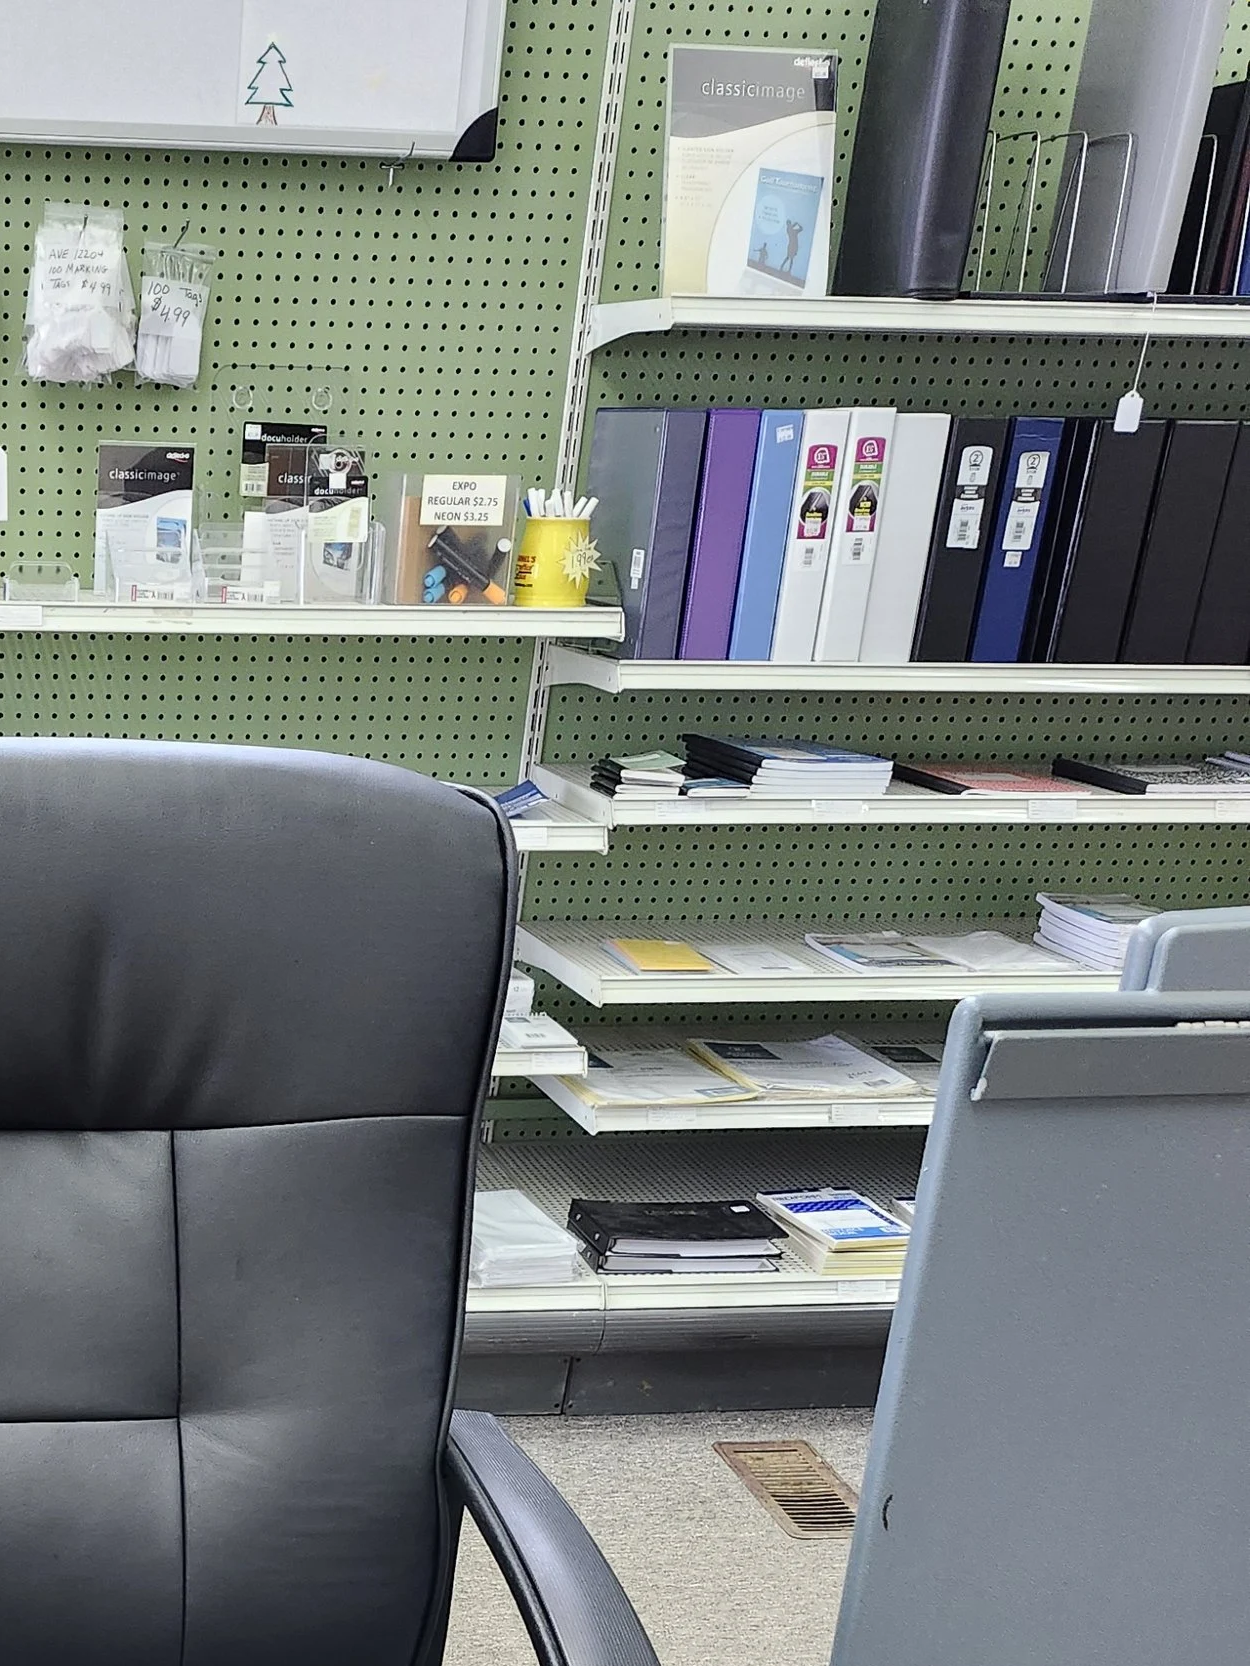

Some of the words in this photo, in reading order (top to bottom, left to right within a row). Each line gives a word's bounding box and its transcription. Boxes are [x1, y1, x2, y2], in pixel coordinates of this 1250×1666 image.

[701, 78, 805, 102] classicimage
[49, 249, 69, 259] AVE
[49, 265, 62, 274] 100
[148, 283, 170, 295] 100
[261, 433, 308, 444] docuholder
[109, 468, 177, 482] classicimage
[452, 481, 477, 491] EXPO
[427, 496, 470, 506] REGULAR
[473, 497, 498, 507] $2.75
[434, 512, 461, 521] NEON
[463, 512, 489, 522] $3.25
